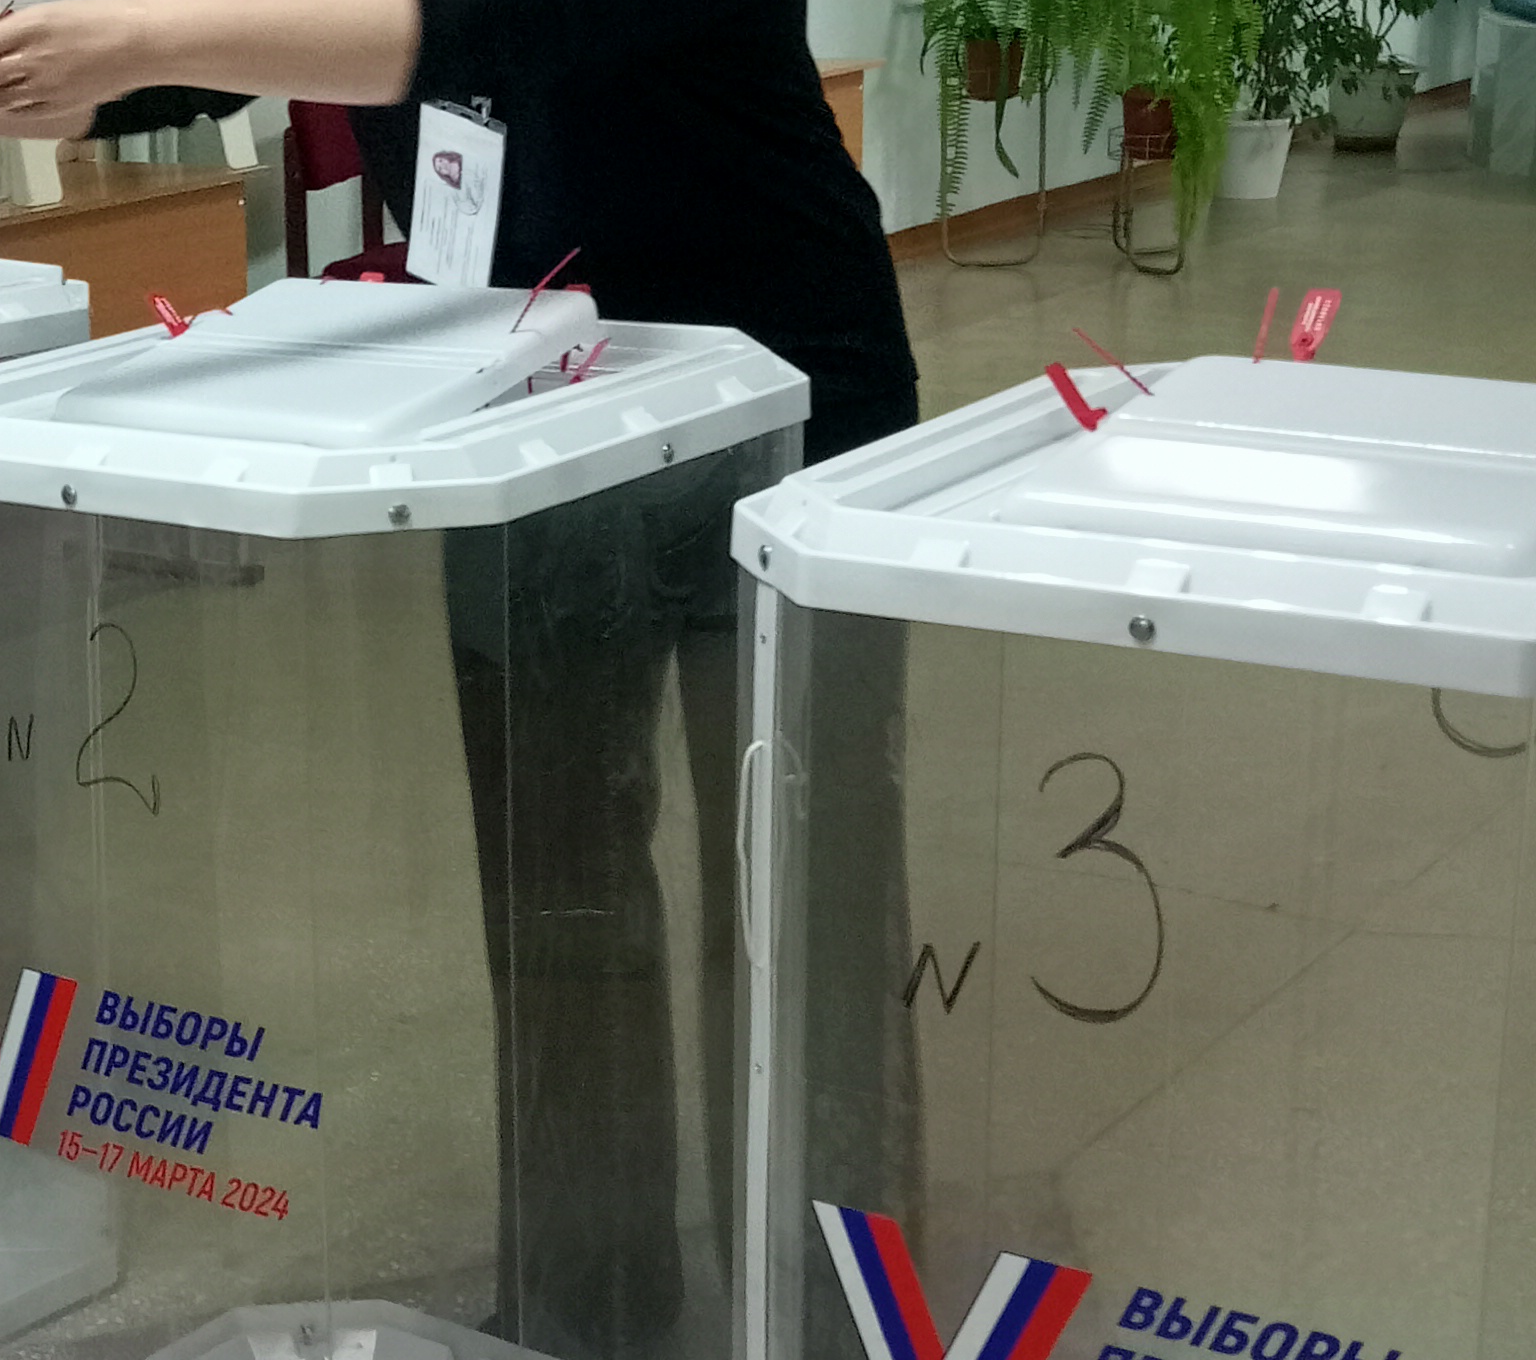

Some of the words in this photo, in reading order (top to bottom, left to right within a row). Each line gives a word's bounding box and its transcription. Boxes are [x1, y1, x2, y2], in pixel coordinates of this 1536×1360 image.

[76, 622, 160, 816] 2
[1031, 751, 1164, 1023] 3
[95, 990, 266, 1062] ВЫБОРЫ
[66, 1084, 213, 1155] РОССИИ
[80, 1037, 323, 1130] ПРЕЗИДЕНТА
[127, 1150, 216, 1202] МАРТА
[220, 1177, 290, 1221] 2024
